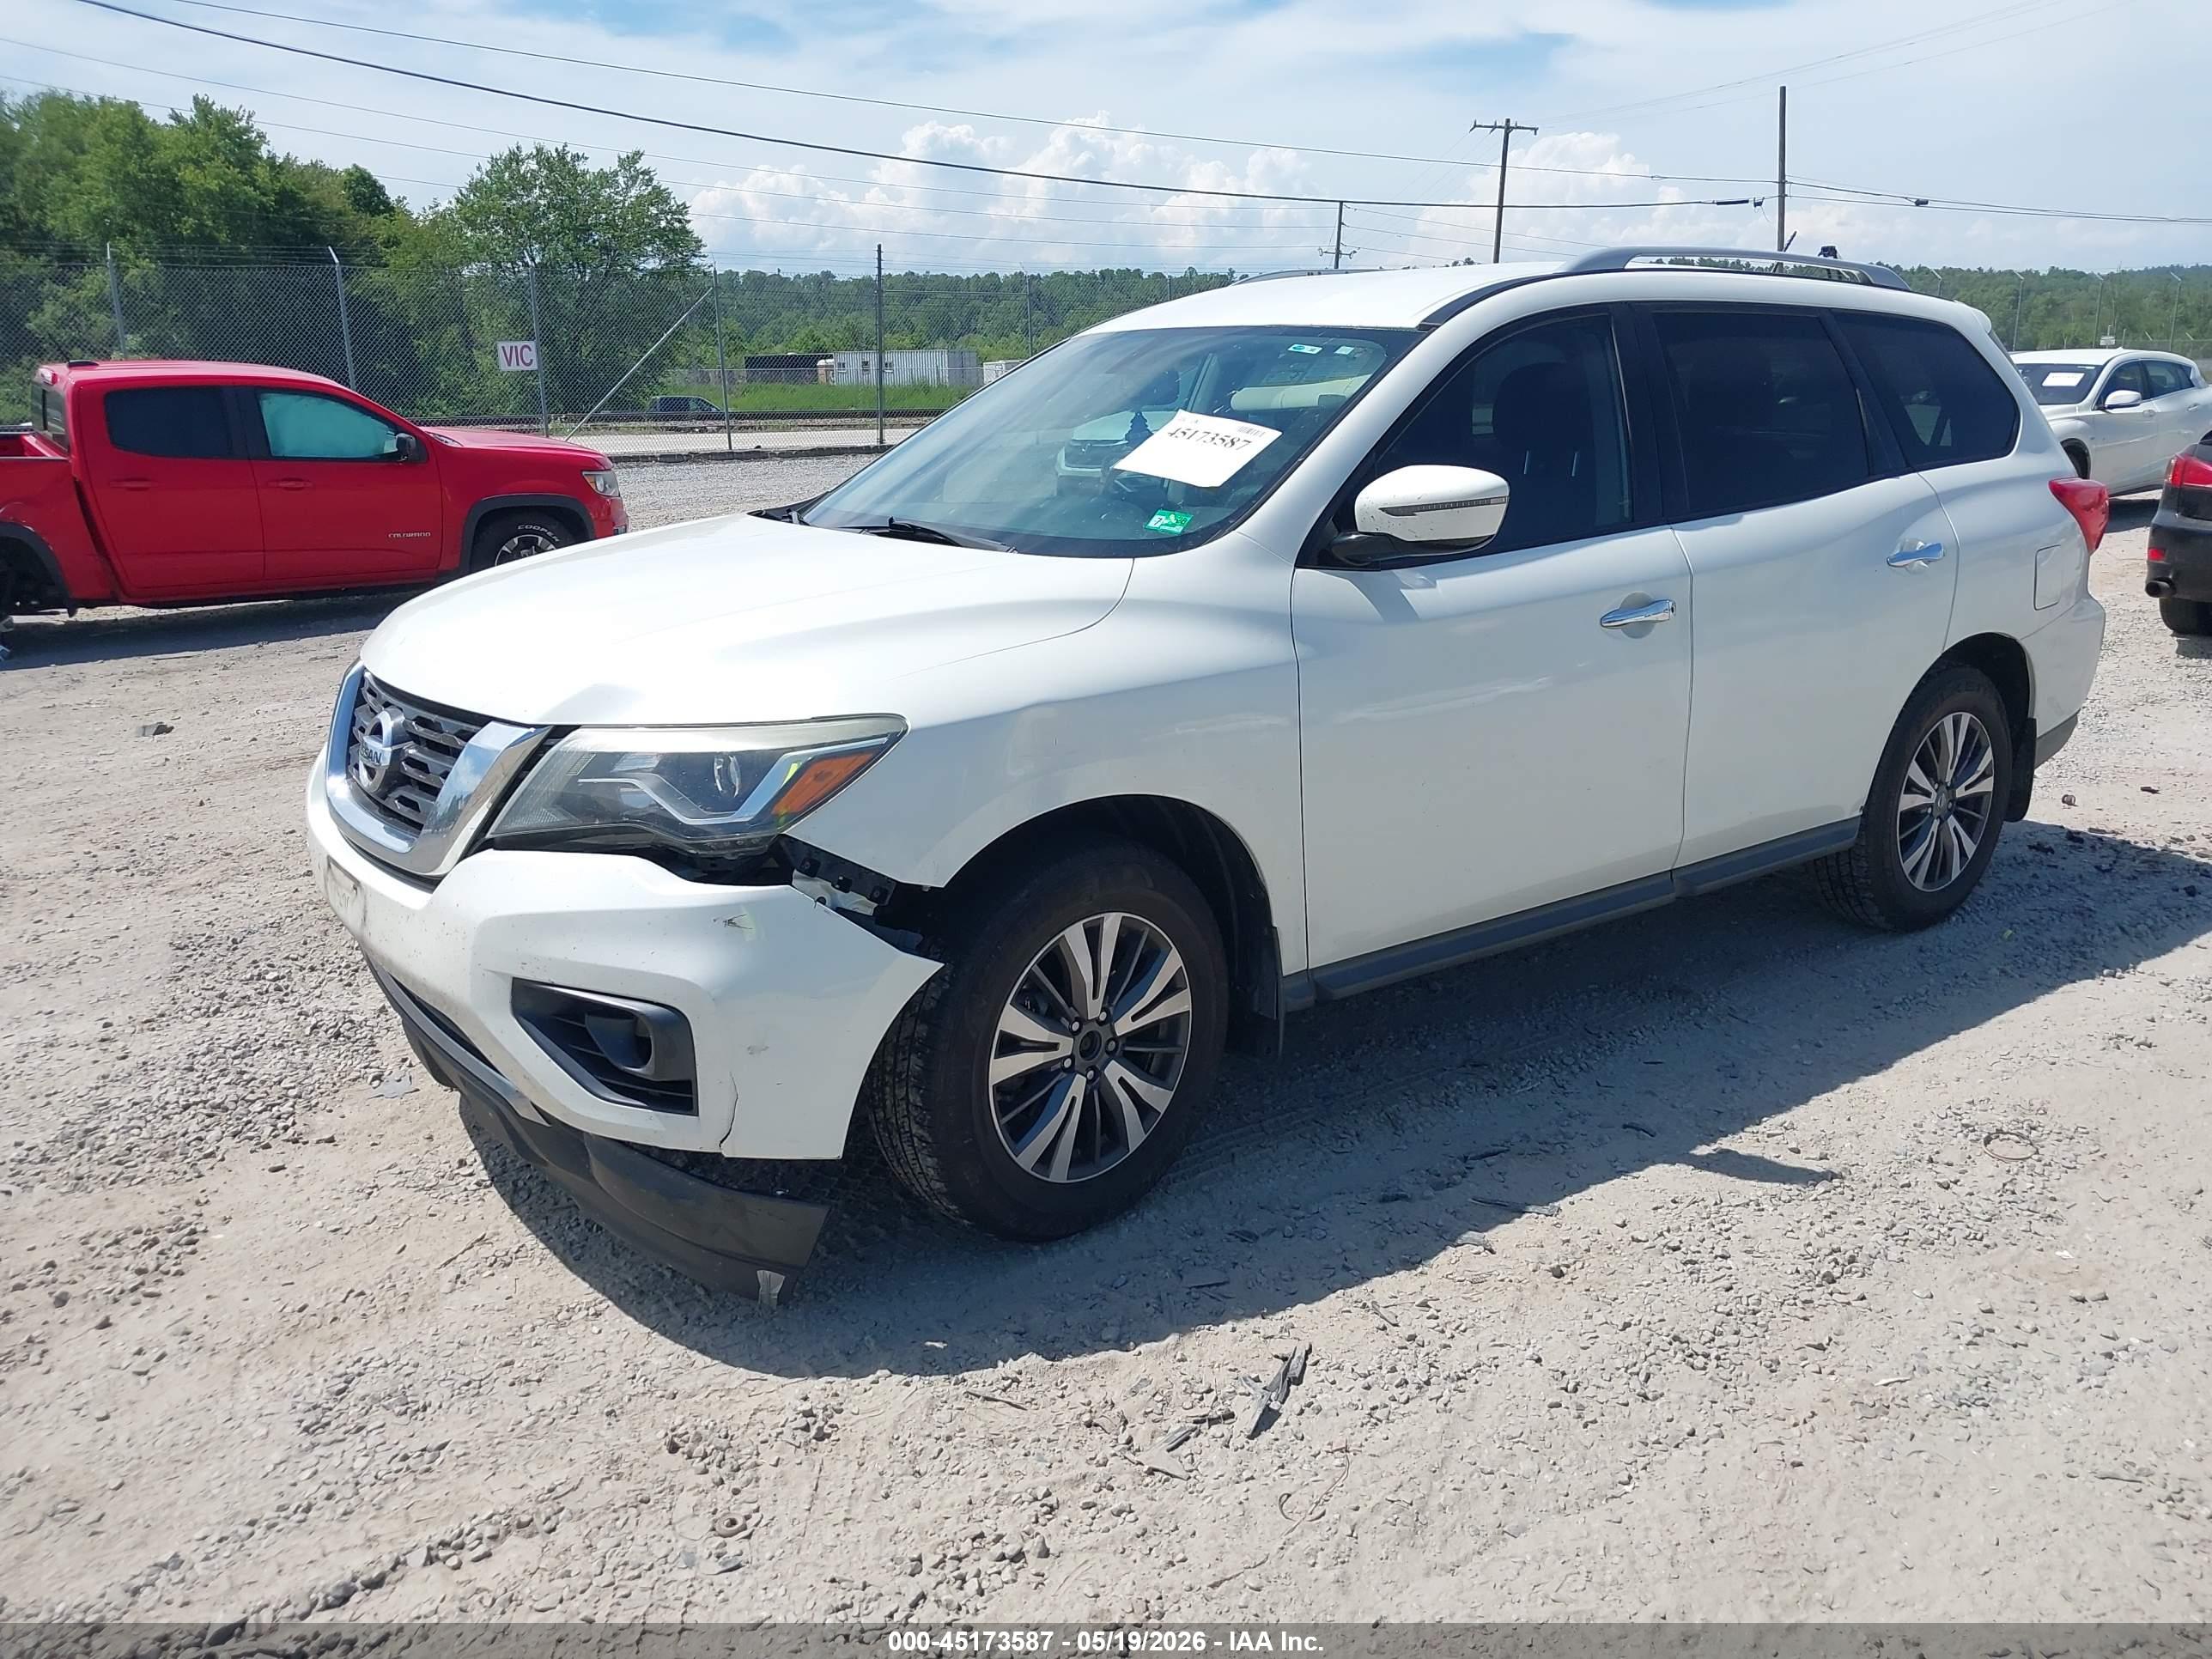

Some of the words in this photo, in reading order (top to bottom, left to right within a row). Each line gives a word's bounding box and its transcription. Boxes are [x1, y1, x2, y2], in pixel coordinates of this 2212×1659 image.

[501, 344, 533, 367] VIC
[1168, 427, 1252, 451] 45173587
[518, 524, 560, 542] COOPER
